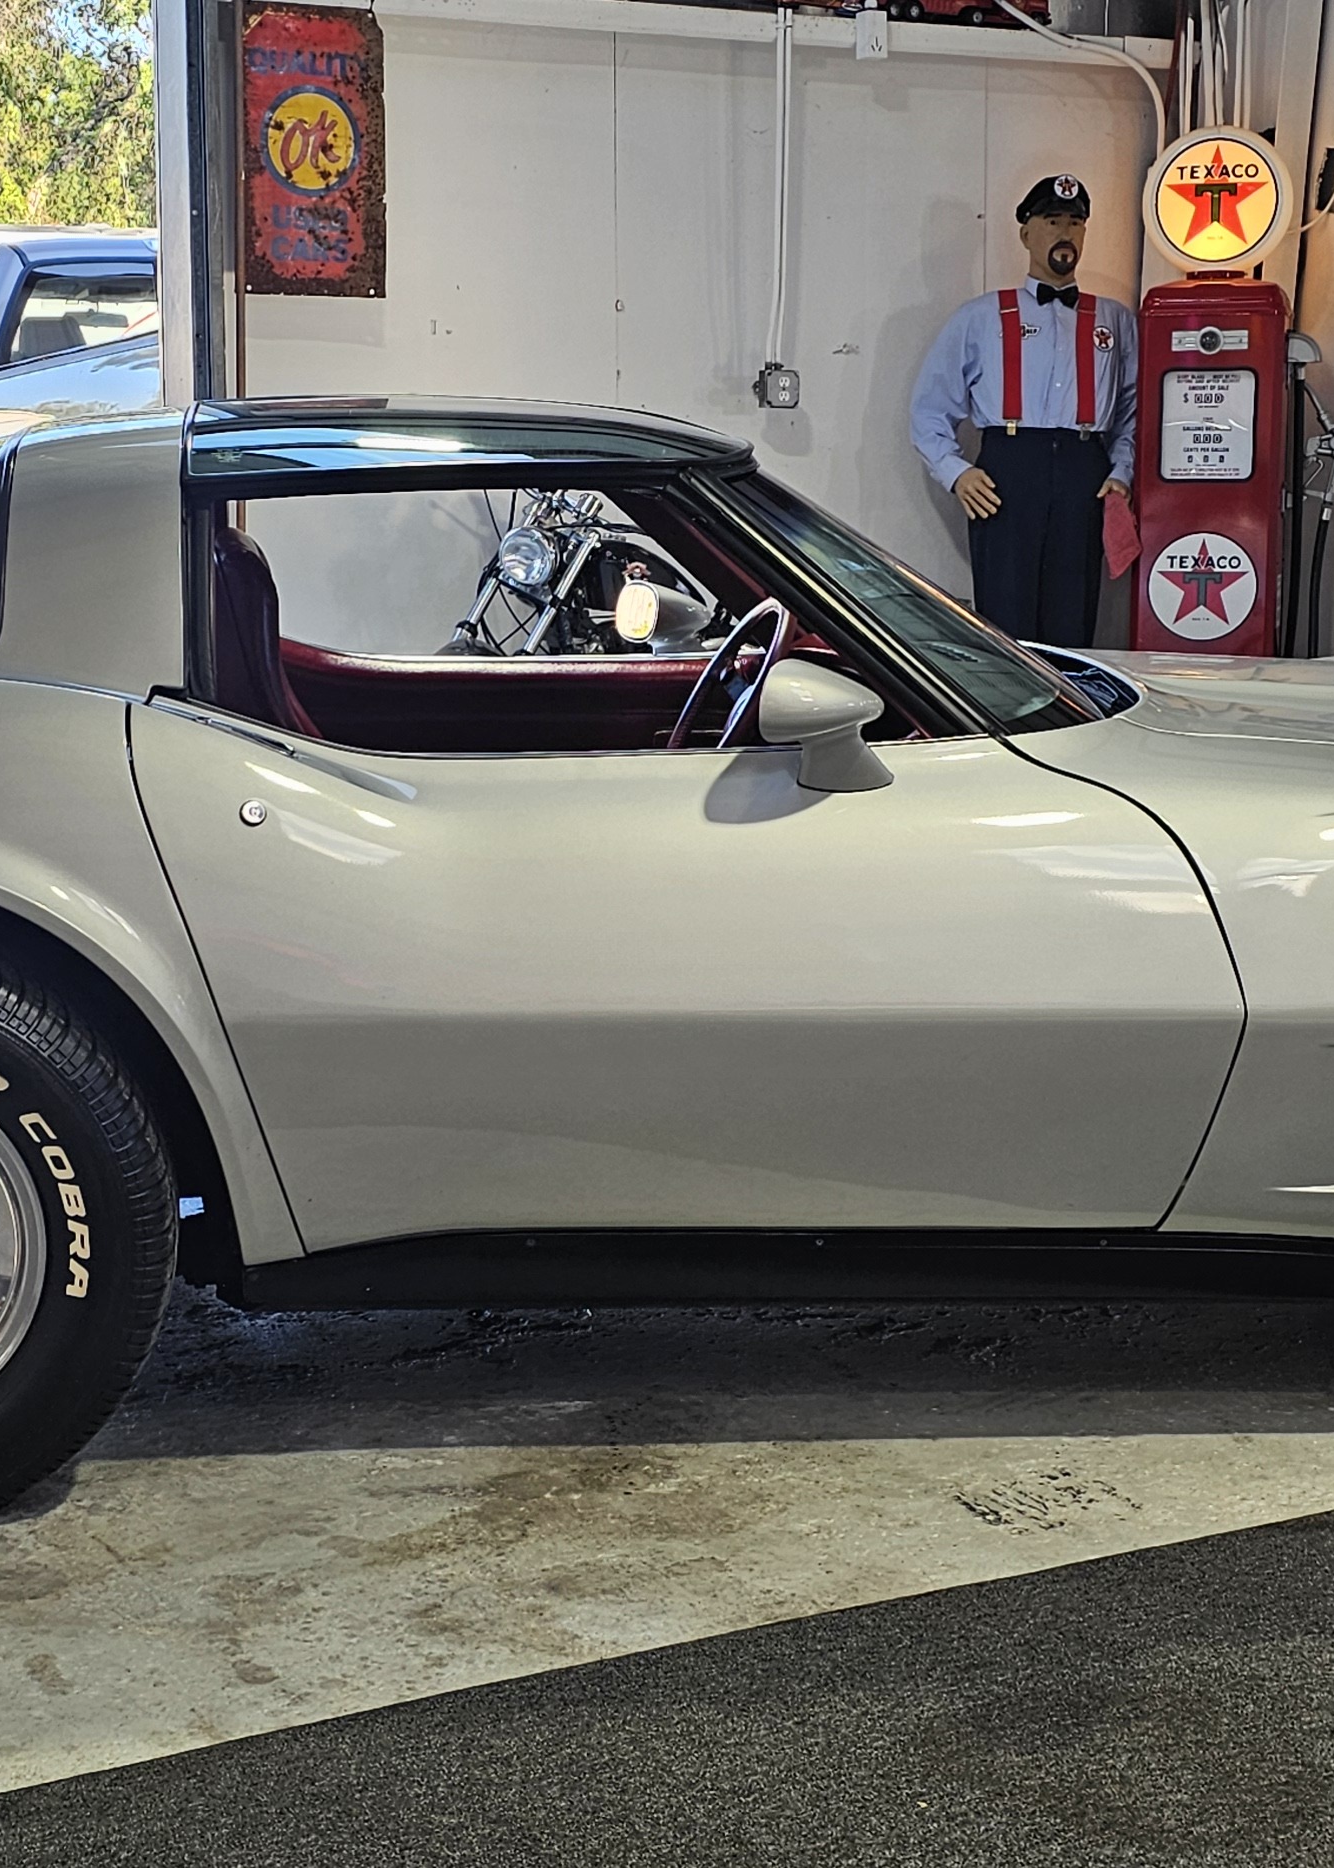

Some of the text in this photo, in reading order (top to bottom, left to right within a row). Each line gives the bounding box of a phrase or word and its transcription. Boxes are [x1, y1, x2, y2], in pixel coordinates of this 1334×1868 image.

[280, 110, 341, 171] OK
[1176, 163, 1259, 180] TEXACO
[1166, 555, 1242, 569] TEXACO
[18, 1112, 92, 1299] COBRA
